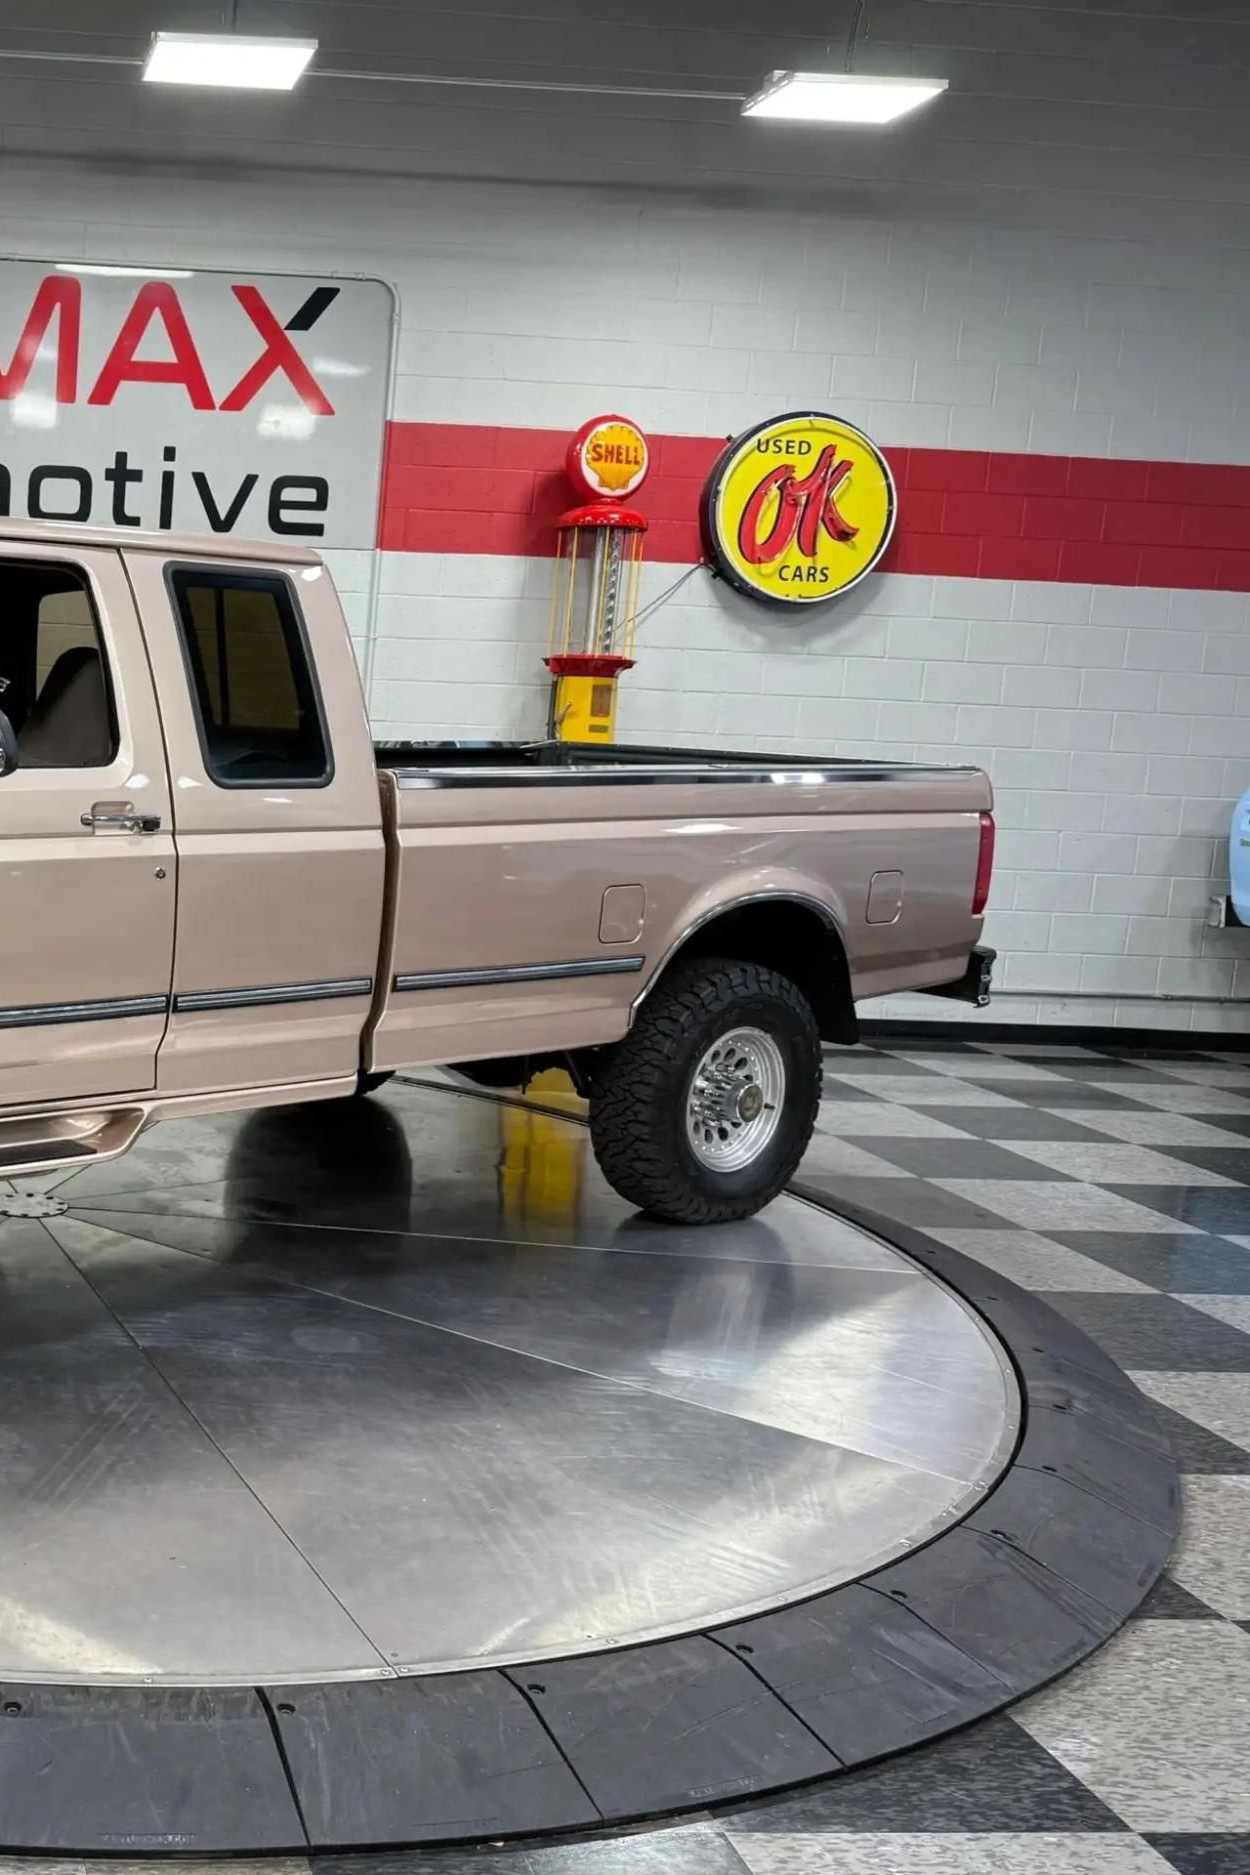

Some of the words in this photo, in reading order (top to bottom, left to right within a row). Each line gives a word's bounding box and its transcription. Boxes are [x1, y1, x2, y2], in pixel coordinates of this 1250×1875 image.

[590, 443, 640, 466] SHELL
[756, 438, 812, 455] USED
[739, 444, 860, 564] OK
[778, 565, 830, 583] CARS
